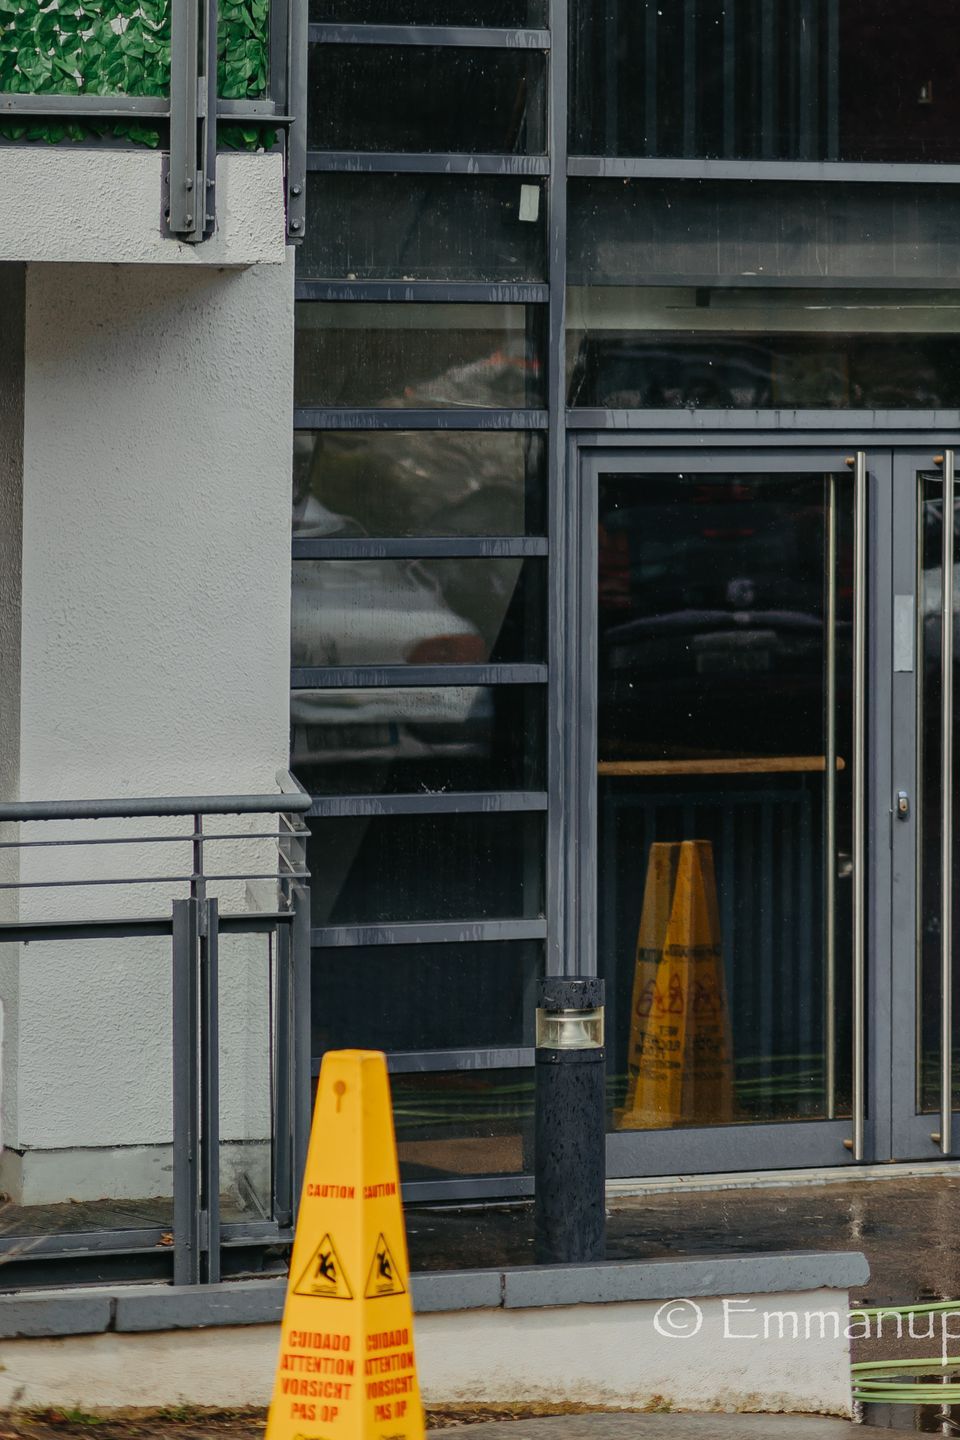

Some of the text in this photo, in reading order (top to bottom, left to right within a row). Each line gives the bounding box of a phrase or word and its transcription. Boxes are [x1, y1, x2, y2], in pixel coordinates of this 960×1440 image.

[306, 1183, 356, 1199] CAUTION
[363, 1182, 396, 1199] CAUTION
[289, 1330, 351, 1352] CUIDADO
[366, 1328, 409, 1352] CUIDADO
[281, 1353, 355, 1377] ATTENTION
[364, 1351, 414, 1376] ATTENTION
[281, 1377, 353, 1401] VORSICHT
[365, 1375, 414, 1400] VORSICHT
[291, 1402, 339, 1423] PAS OP
[374, 1400, 407, 1422] PAS OP
